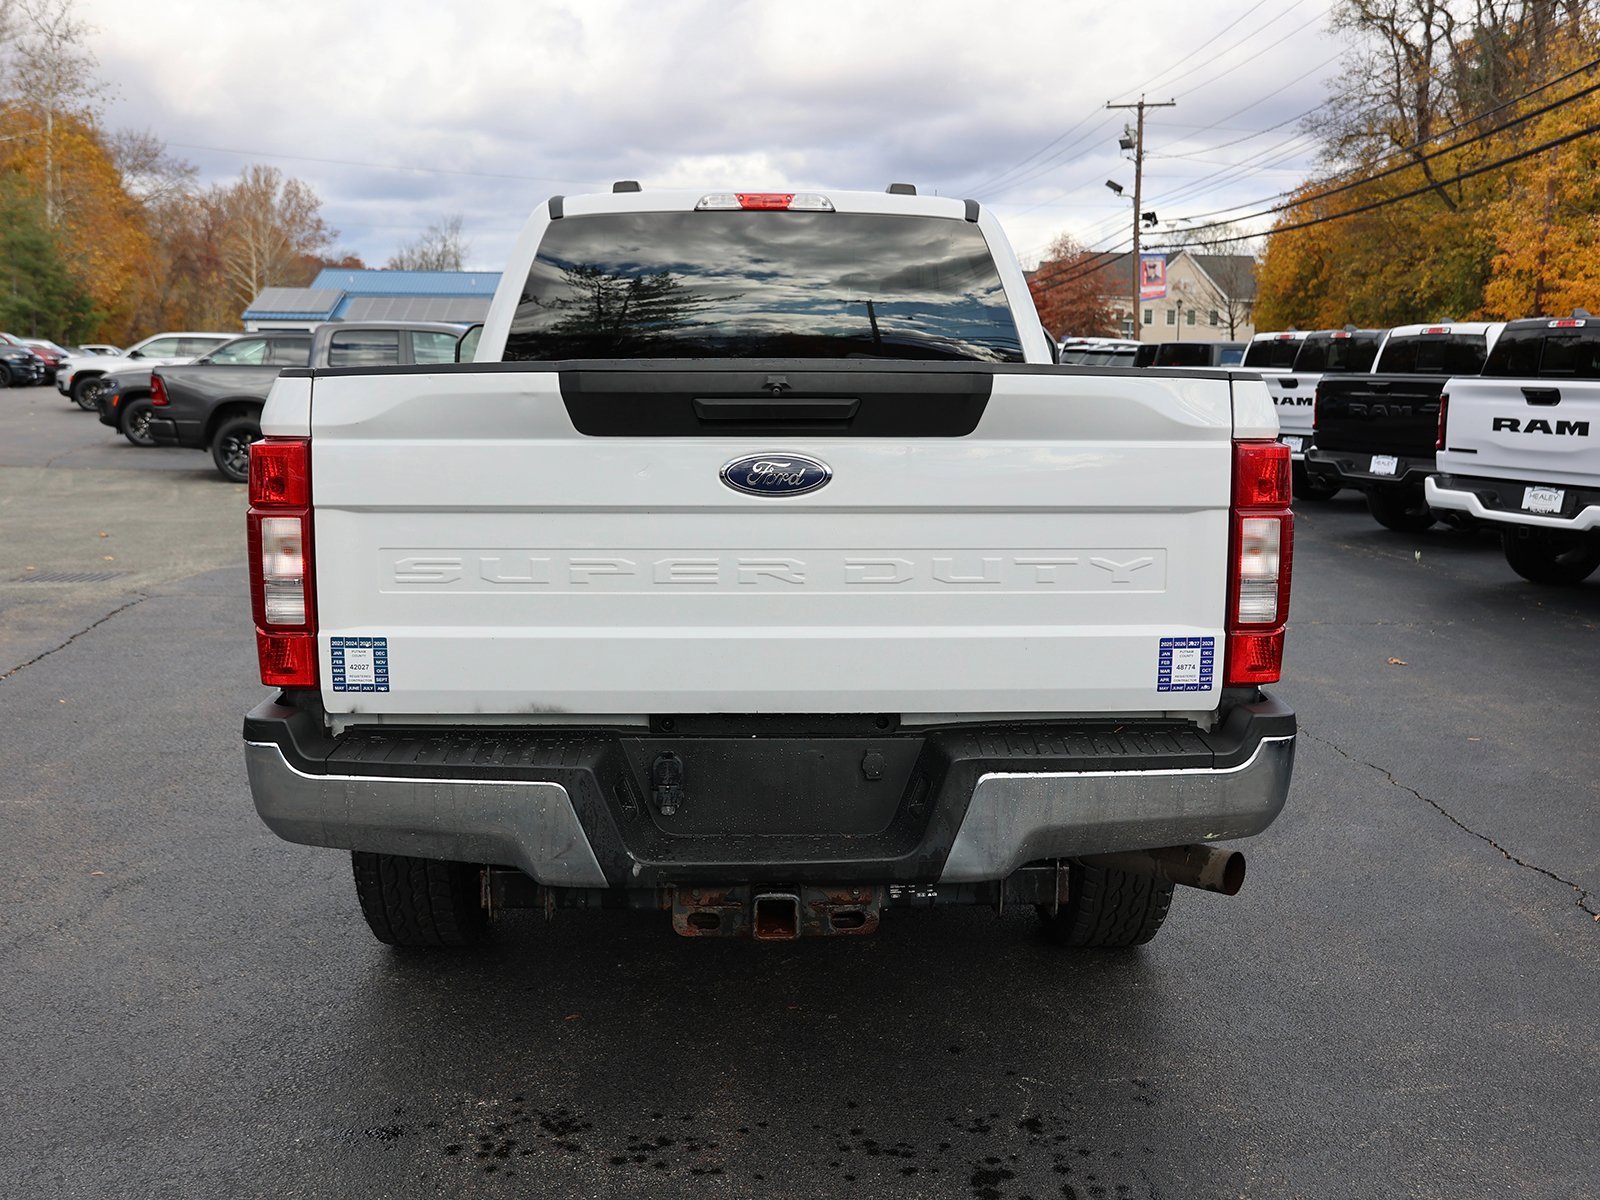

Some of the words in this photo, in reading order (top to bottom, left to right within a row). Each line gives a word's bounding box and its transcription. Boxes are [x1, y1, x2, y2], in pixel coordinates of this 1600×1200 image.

[1348, 403, 1413, 417] RAM
[1492, 417, 1590, 437] RAM
[746, 461, 806, 486] Ford
[1529, 492, 1559, 501] HEALEY
[394, 556, 806, 585] SUPER
[844, 556, 1153, 584] DUTY
